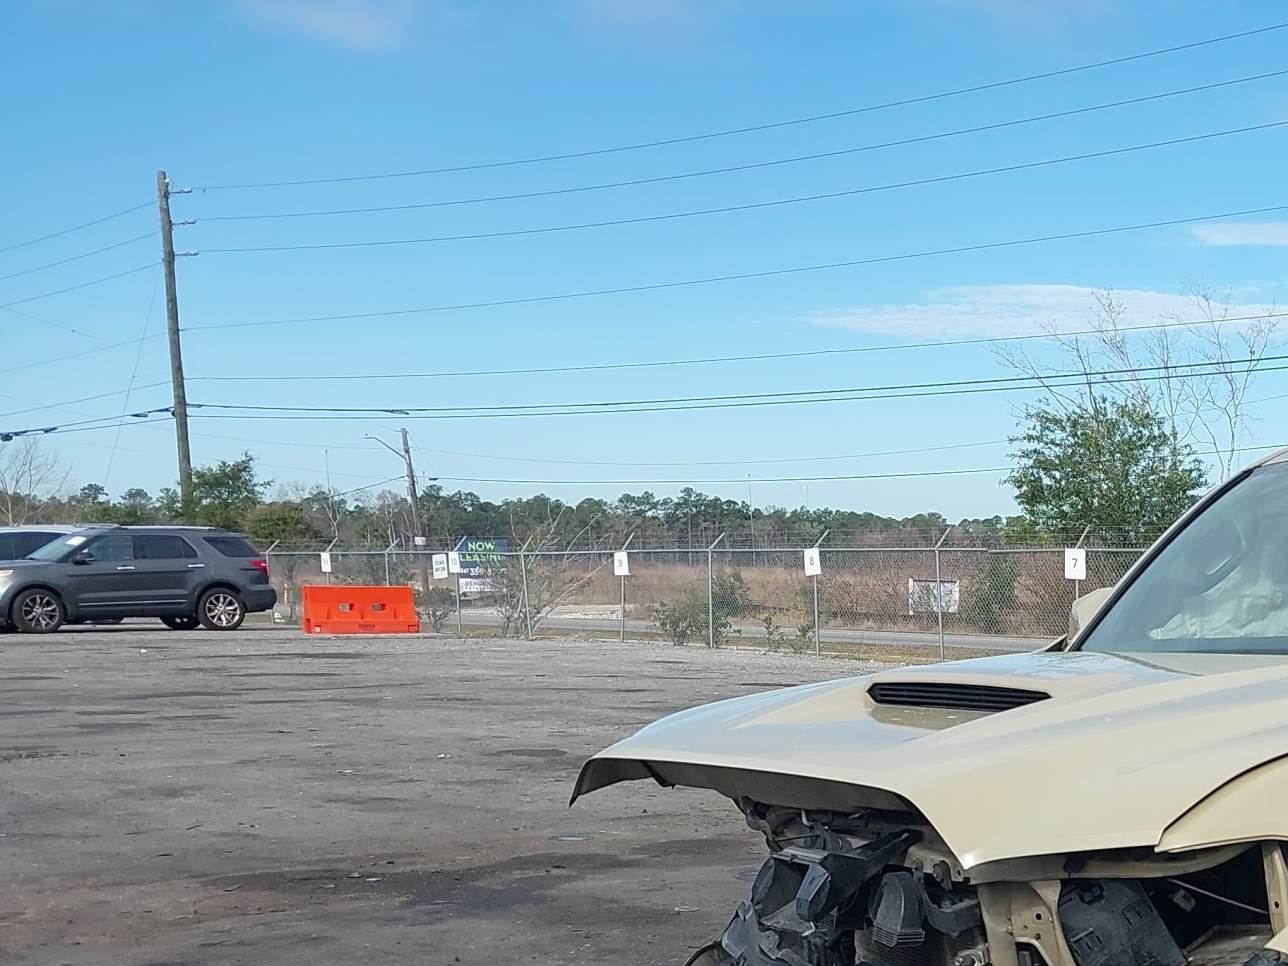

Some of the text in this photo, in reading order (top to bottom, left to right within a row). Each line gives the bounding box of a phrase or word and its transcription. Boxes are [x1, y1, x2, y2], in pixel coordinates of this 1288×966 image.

[468, 541, 495, 551] NOW
[617, 558, 623, 567] 9
[809, 556, 815, 566] 8
[1071, 557, 1078, 569] 7
